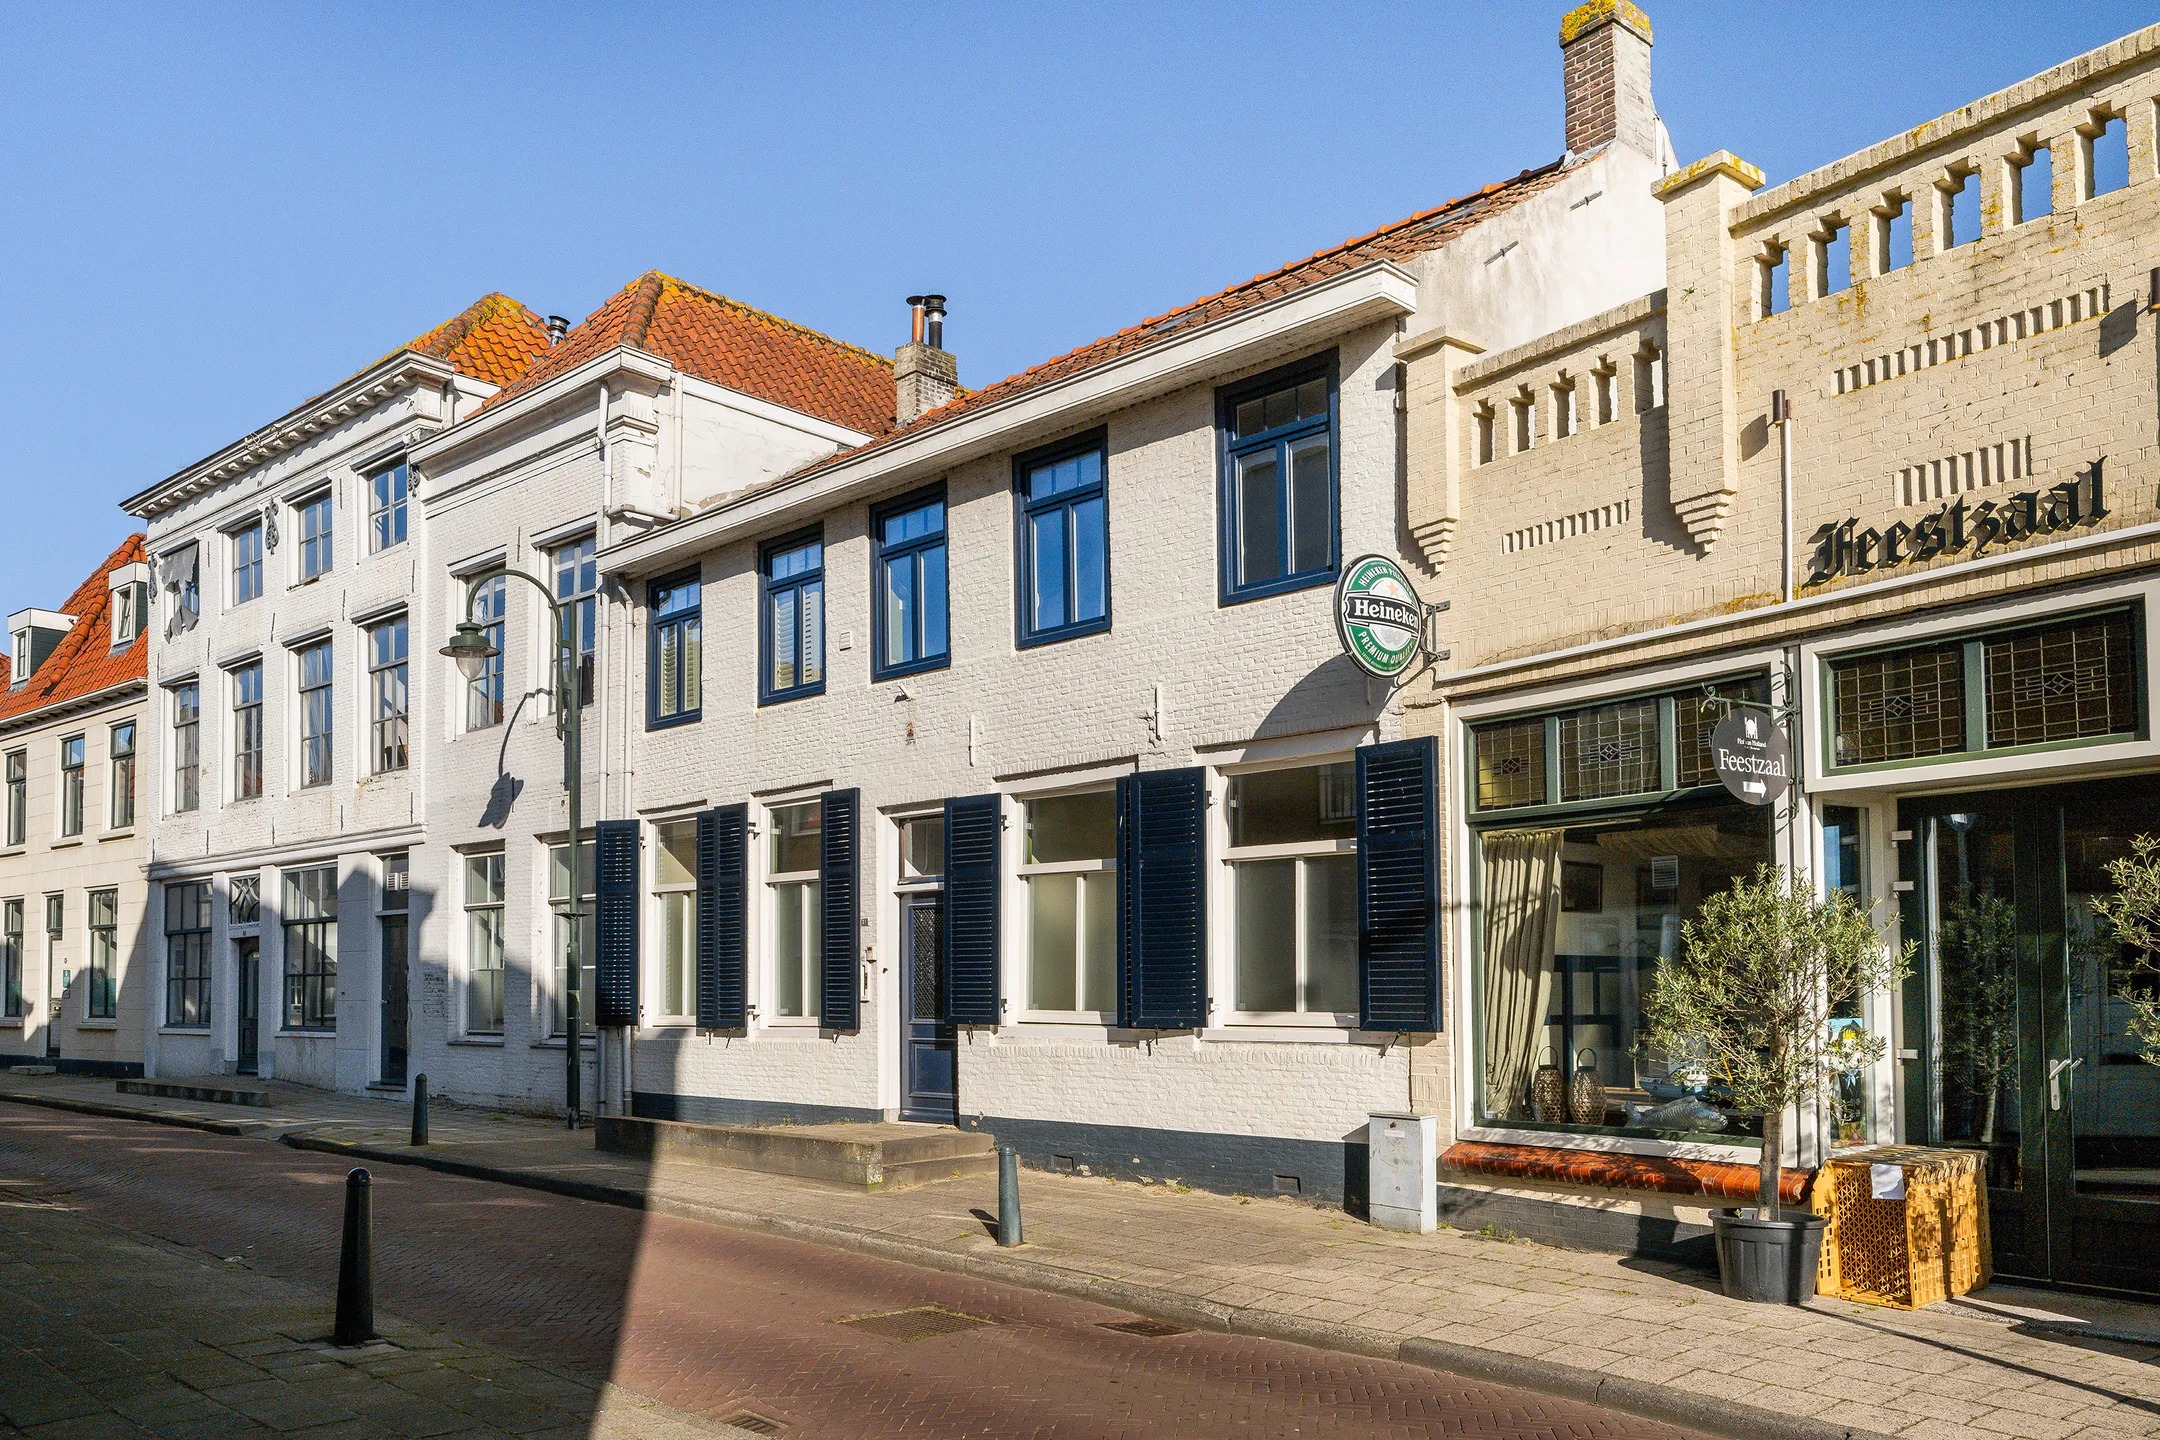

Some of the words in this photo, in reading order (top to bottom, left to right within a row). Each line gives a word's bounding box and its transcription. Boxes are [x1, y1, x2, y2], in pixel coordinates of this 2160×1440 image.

[1801, 455, 2111, 589] Feestzaal
[1358, 566, 1389, 587] HEINEKEN
[1354, 599, 1420, 628] Heineken
[1358, 631, 1389, 664] PREMIUM
[1719, 748, 1787, 777] Feestzaal
